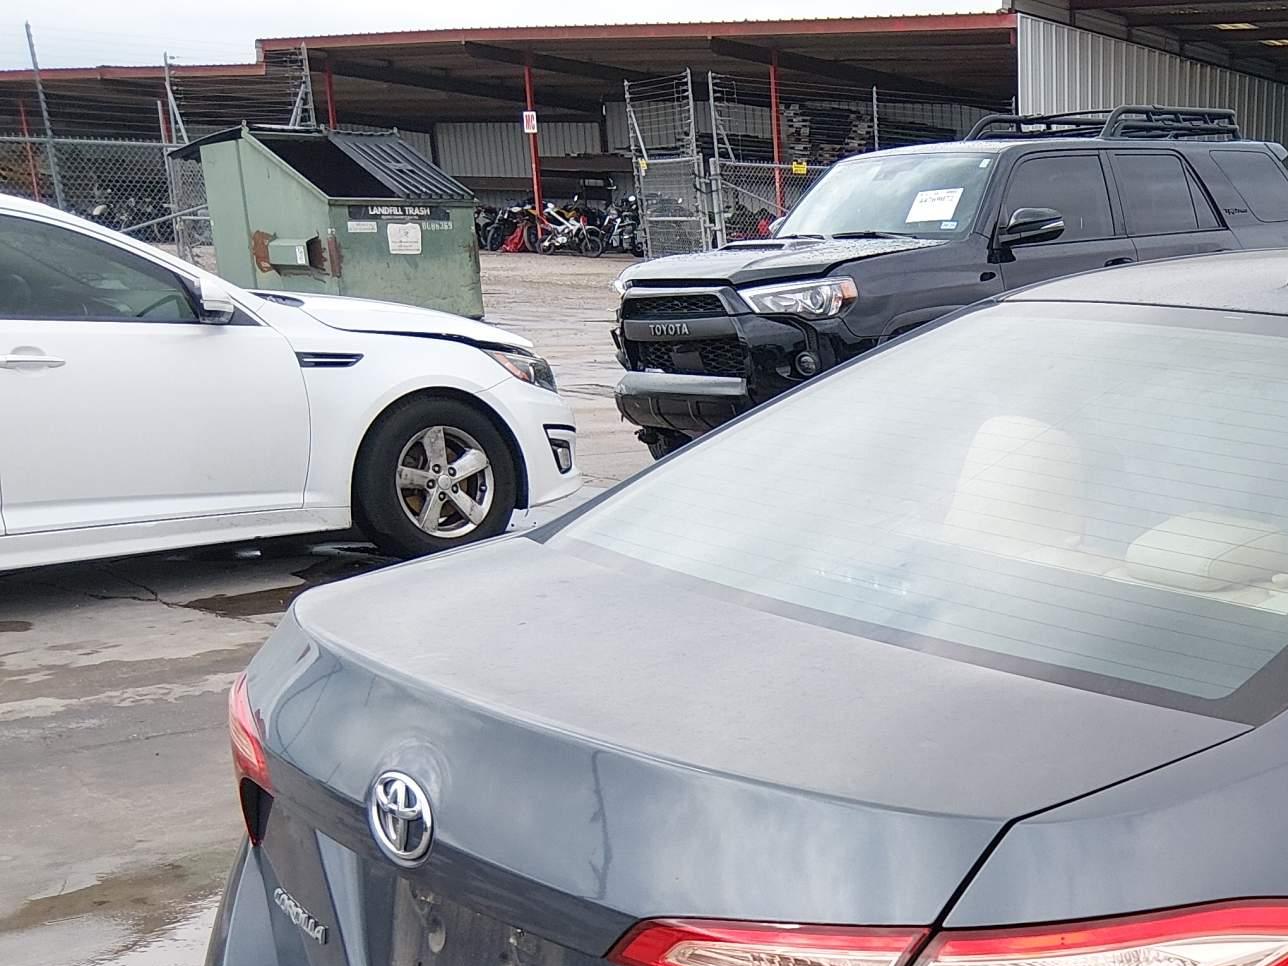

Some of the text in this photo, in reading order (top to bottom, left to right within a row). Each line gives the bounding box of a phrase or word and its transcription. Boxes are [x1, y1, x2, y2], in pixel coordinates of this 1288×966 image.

[368, 206, 431, 216] LANDFILL TRASH
[649, 323, 689, 335] TOYOTA
[273, 887, 327, 945] COROLLA
